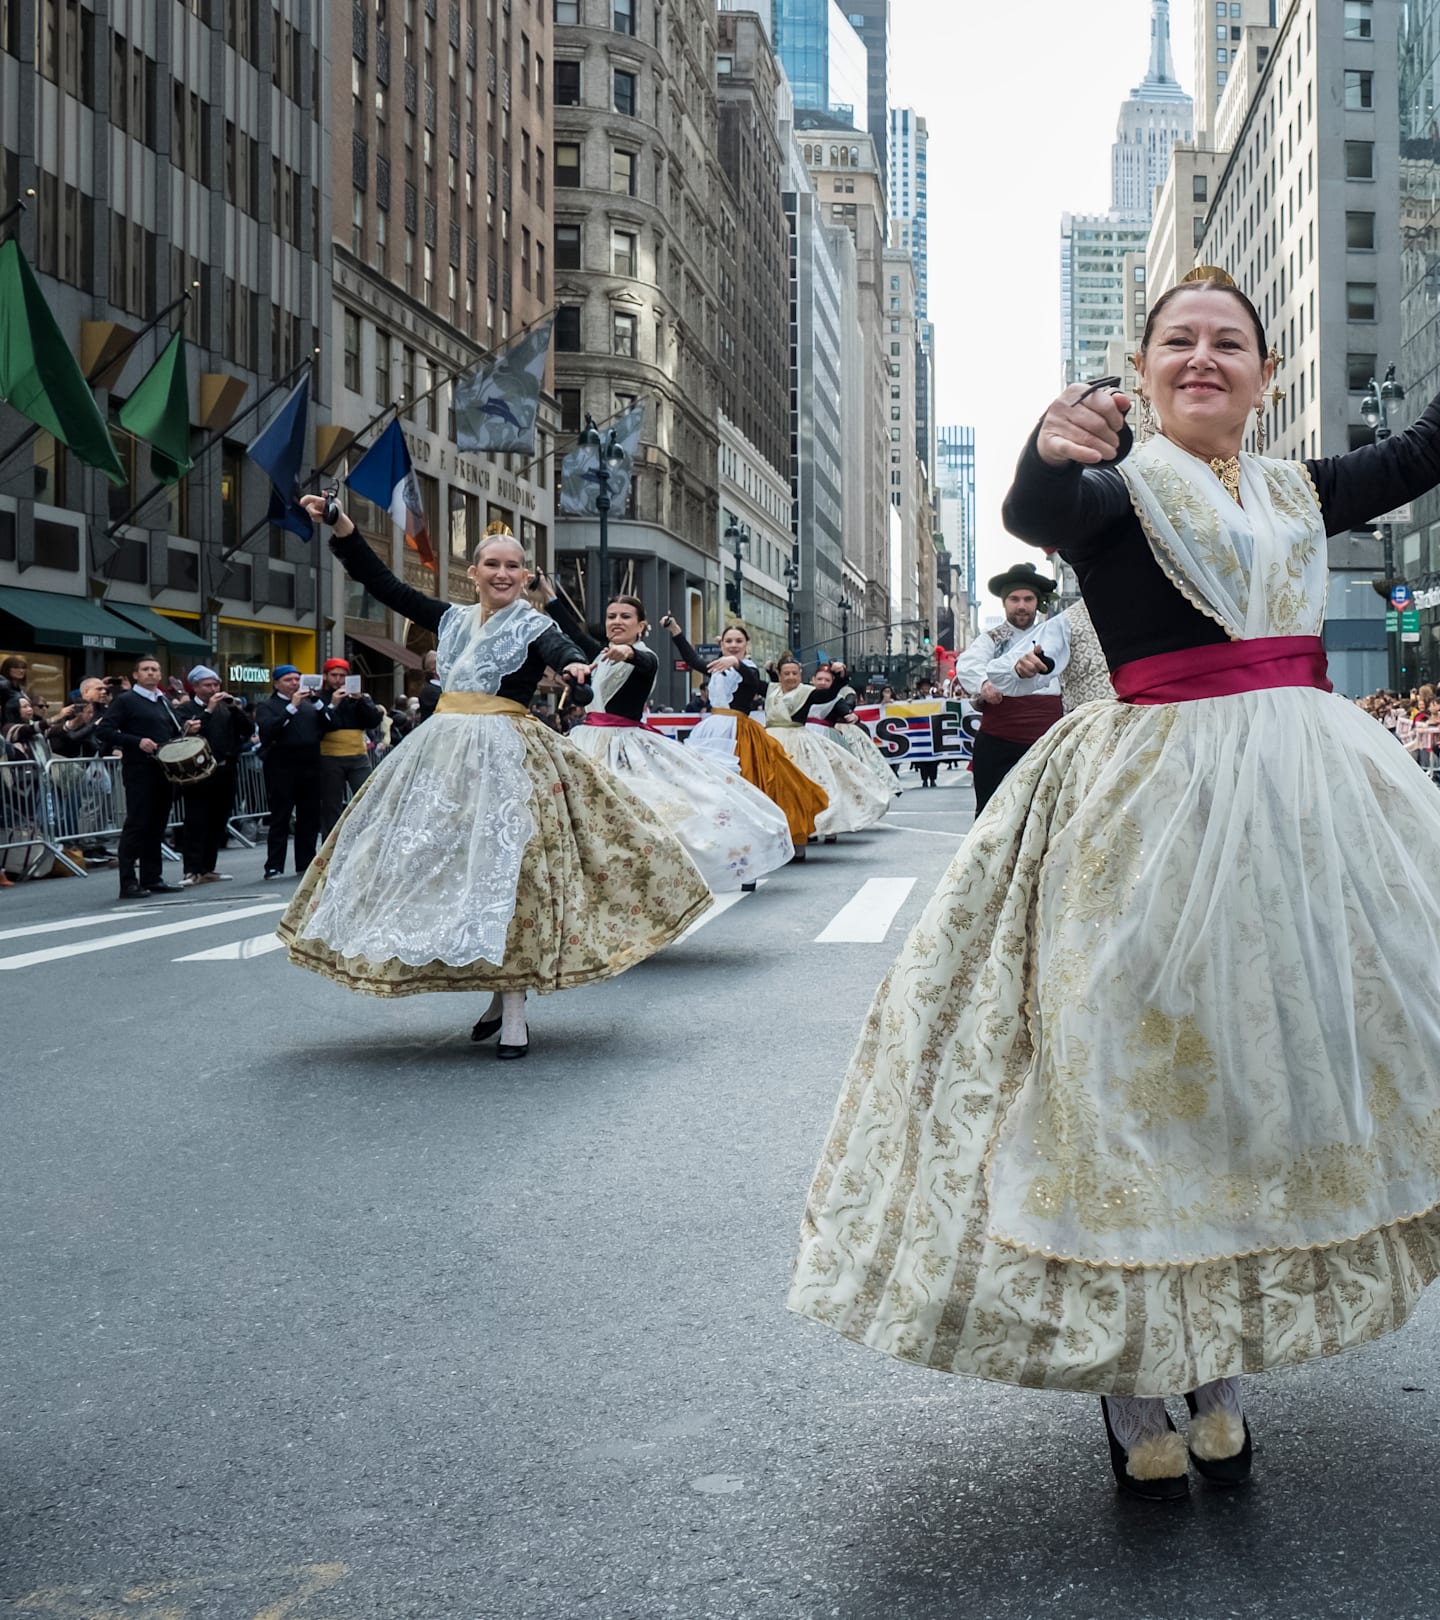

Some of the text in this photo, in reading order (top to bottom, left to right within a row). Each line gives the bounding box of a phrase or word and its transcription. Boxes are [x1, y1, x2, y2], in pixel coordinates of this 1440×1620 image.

[404, 430, 431, 463] RED
[454, 456, 490, 491] FRENCH
[497, 478, 536, 511] BUILDING
